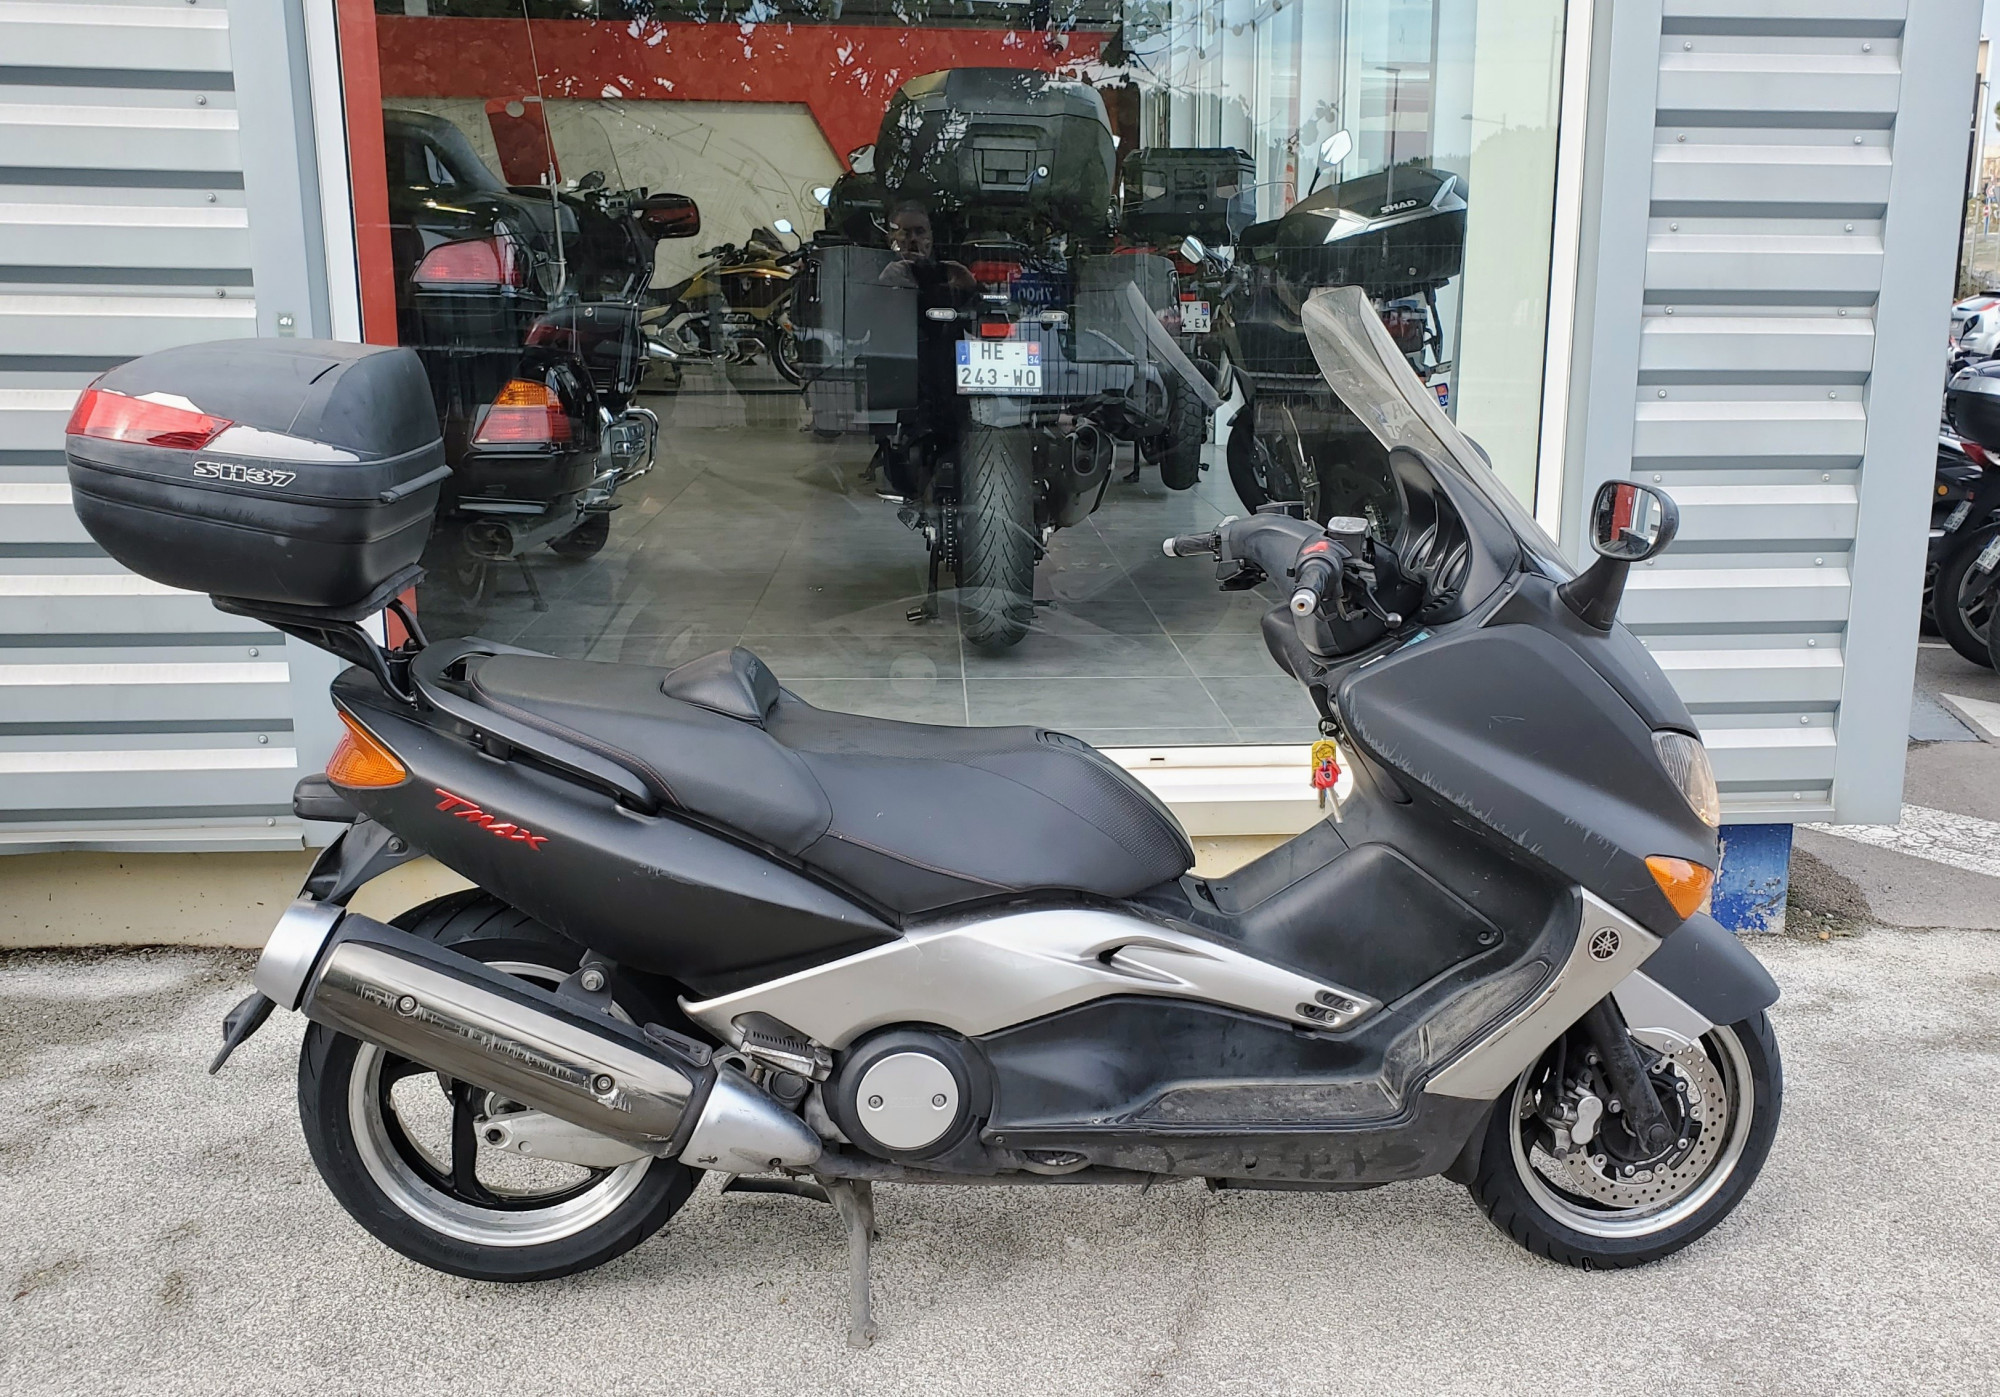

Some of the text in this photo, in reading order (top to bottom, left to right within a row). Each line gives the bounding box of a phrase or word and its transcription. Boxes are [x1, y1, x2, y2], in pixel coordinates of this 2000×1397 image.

[1380, 199, 1417, 214] SHAD
[981, 343, 1004, 360] HE
[1028, 355, 1039, 364] 34
[193, 461, 297, 488] SH37
[435, 788, 550, 851] TMAX
